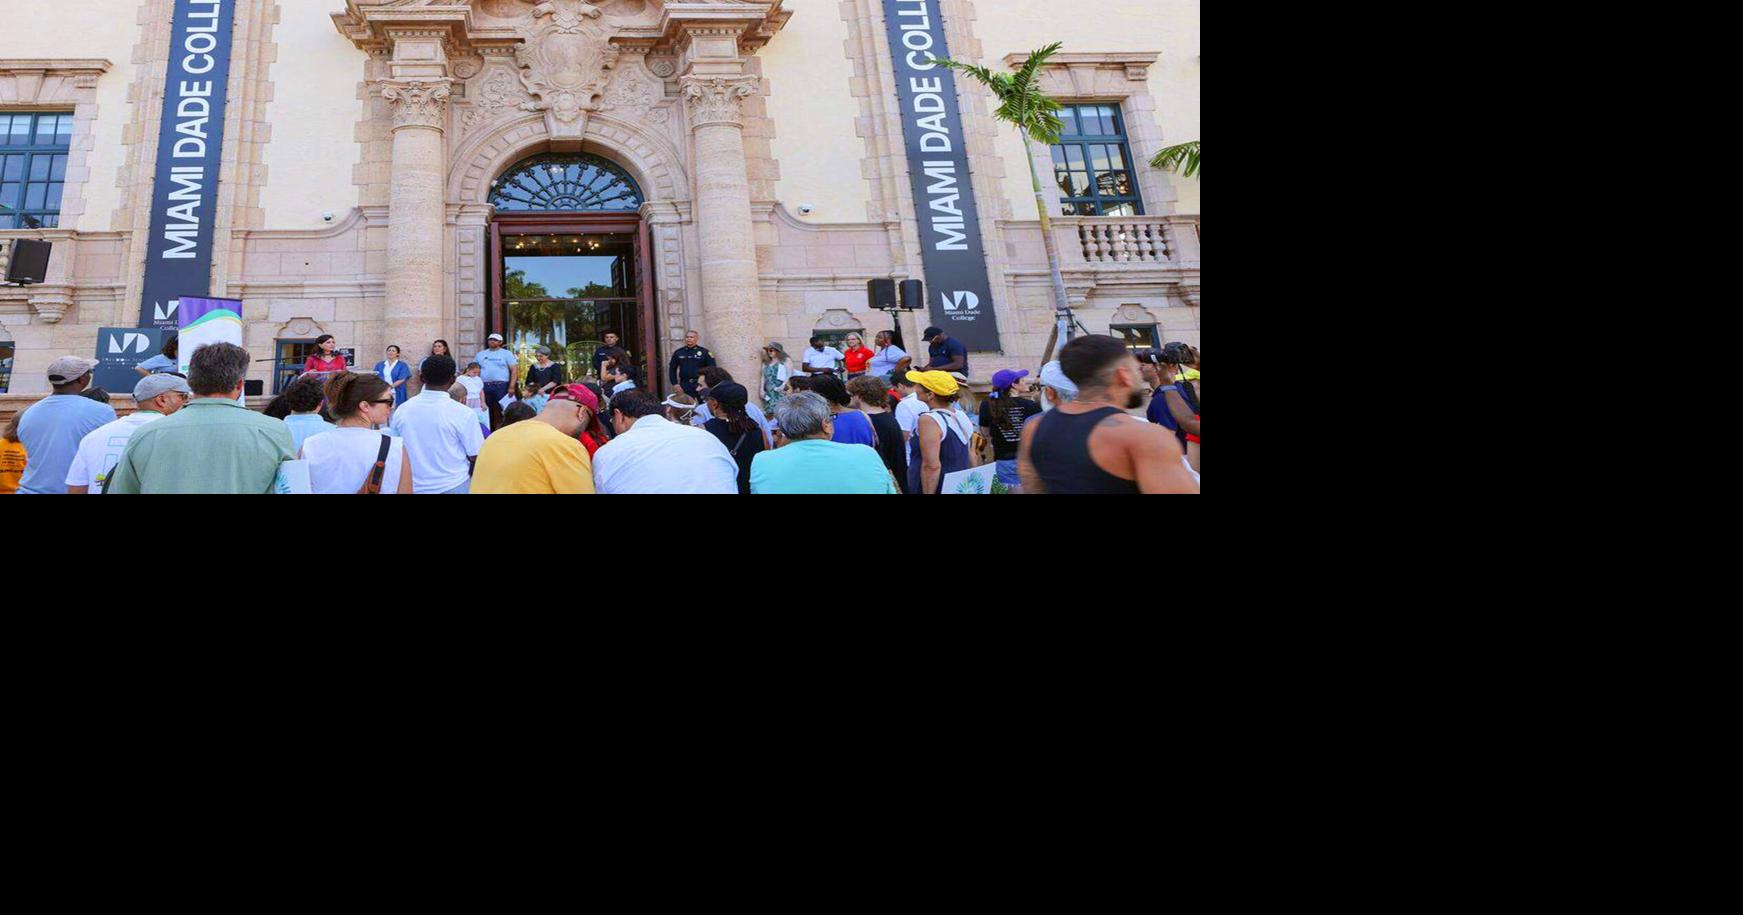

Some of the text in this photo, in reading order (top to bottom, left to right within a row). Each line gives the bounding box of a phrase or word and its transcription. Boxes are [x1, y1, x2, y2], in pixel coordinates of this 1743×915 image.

[162, 0, 220, 259] MIAMI DADE COLL
[910, 77, 952, 152] DADE
[923, 160, 968, 250] MIAMI
